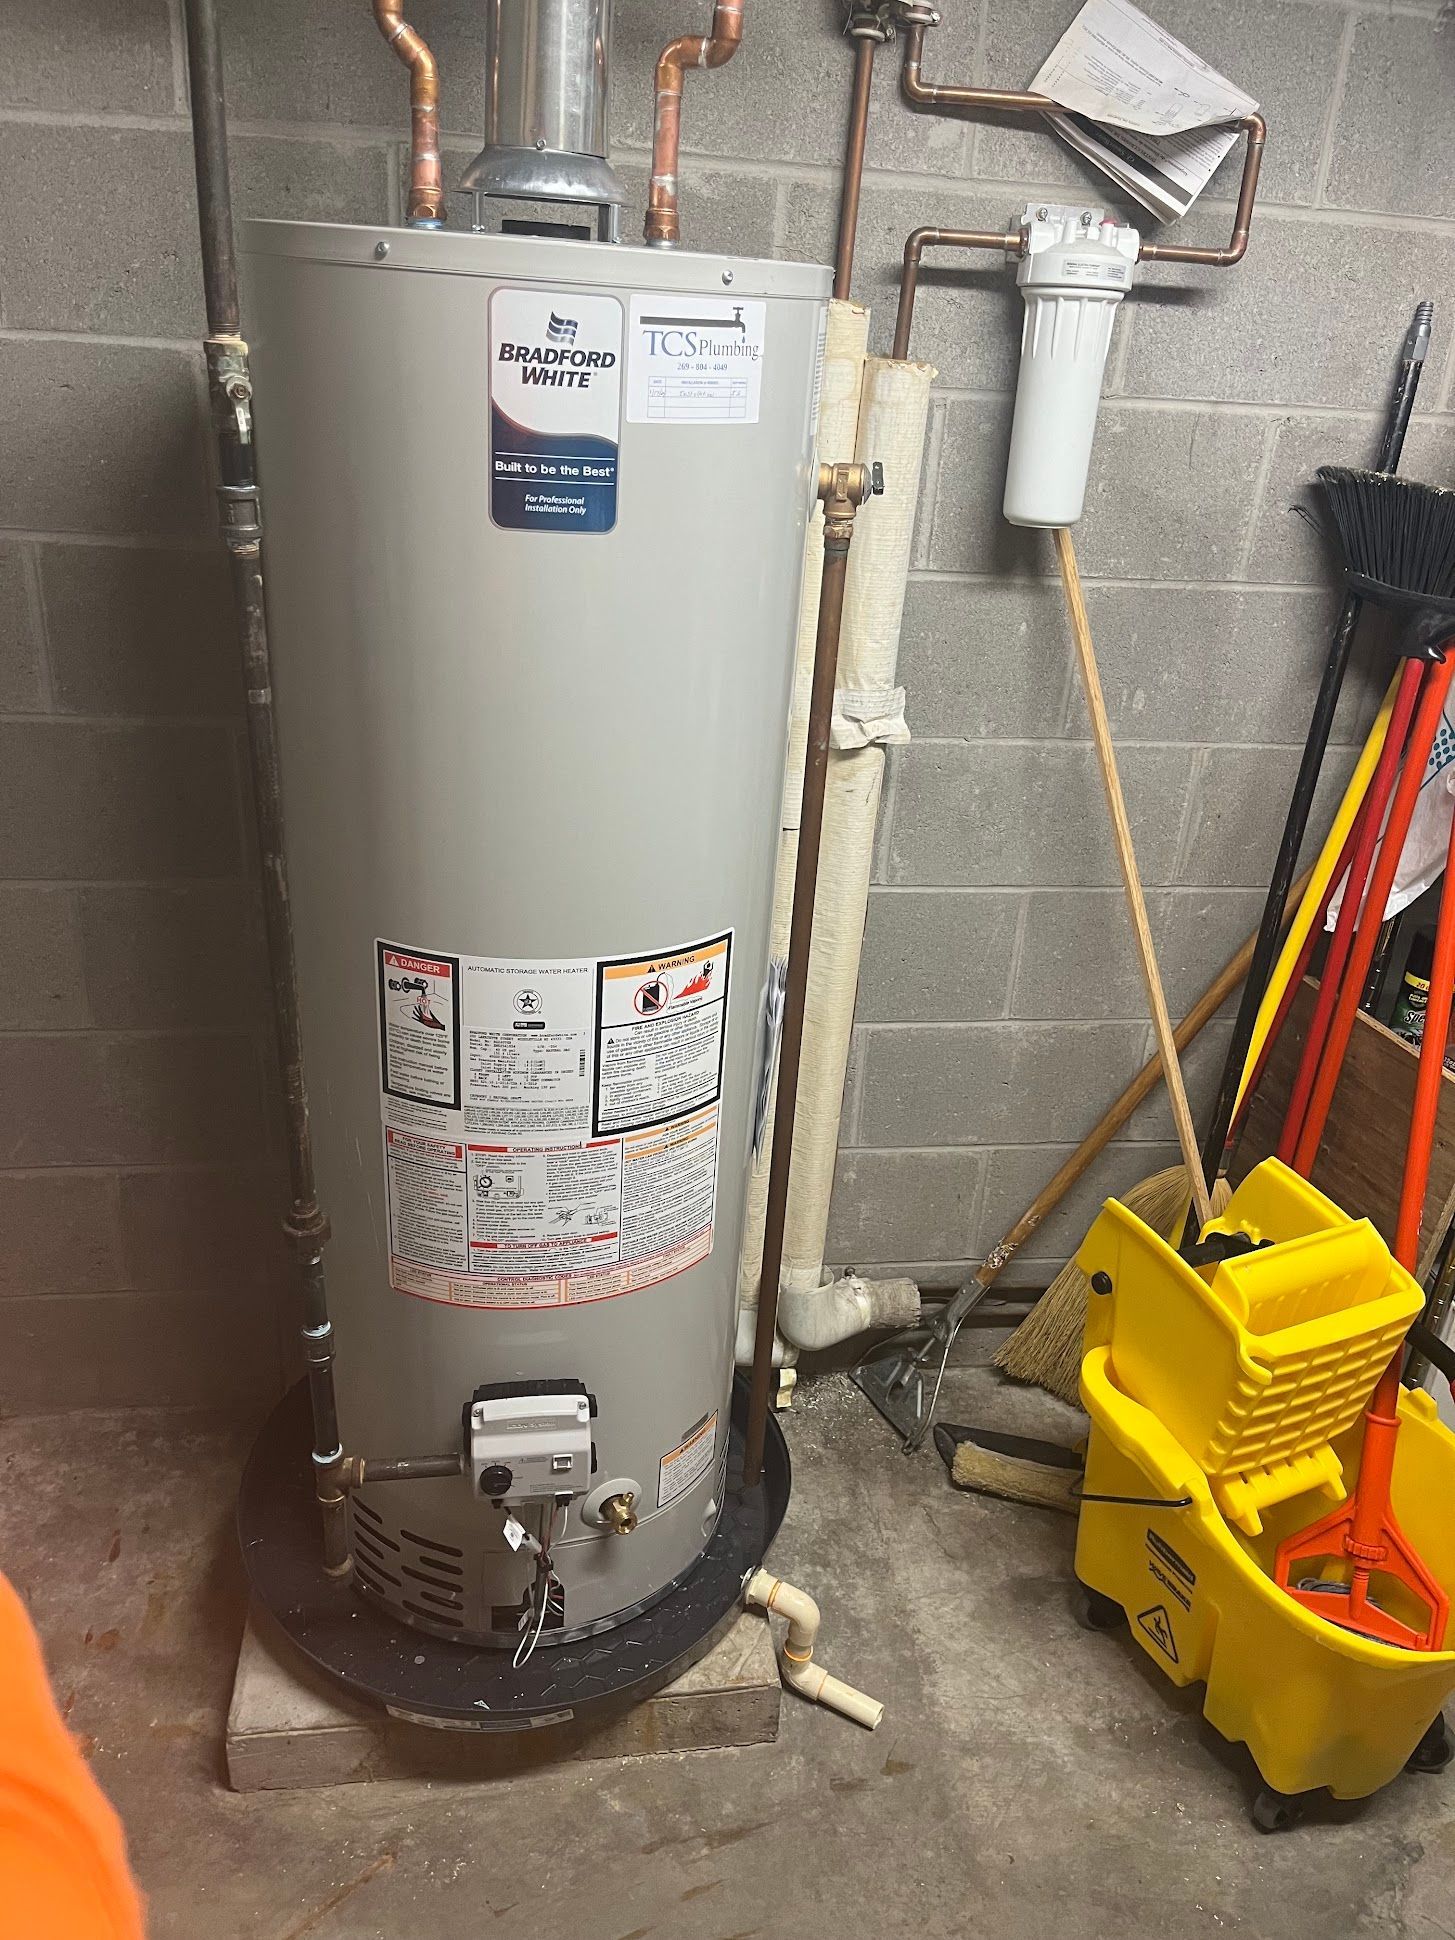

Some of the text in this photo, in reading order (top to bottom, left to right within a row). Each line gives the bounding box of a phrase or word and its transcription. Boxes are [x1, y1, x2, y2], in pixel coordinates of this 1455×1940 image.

[643, 330, 759, 361] TCS Plumbing
[499, 343, 615, 368] BRADFORD
[495, 461, 521, 473] Built
[525, 463, 536, 474] to
[541, 464, 556, 474] be
[560, 465, 579, 476] the
[525, 495, 584, 505] For Professional
[525, 504, 586, 515] Installation Only
[401, 959, 440, 973] DANGER
[659, 956, 694, 970] WARNING
[656, 1015, 681, 1026] EXPLOSION
[682, 1010, 699, 1019] HAZARD
